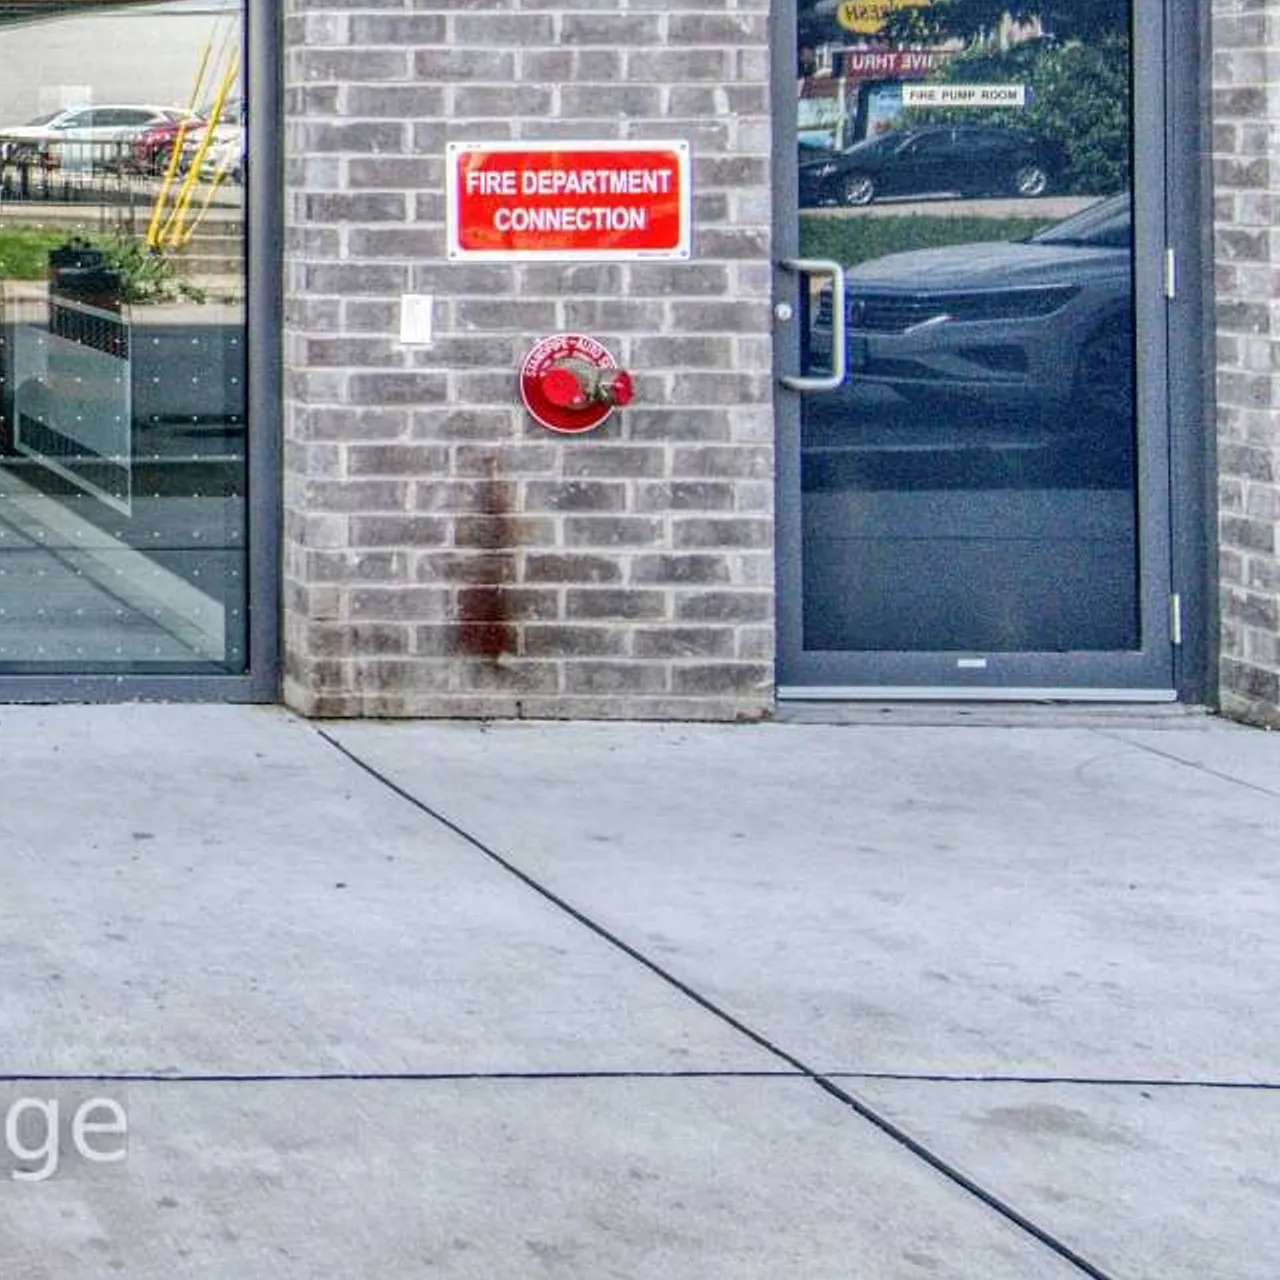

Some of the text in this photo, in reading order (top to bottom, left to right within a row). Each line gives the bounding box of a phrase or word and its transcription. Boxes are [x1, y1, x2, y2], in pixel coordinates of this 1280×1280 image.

[910, 91, 1017, 100] FIRE PUMP ROOM
[466, 169, 672, 195] FIRE DEPARTMENT
[494, 207, 646, 231] CONNECTION
